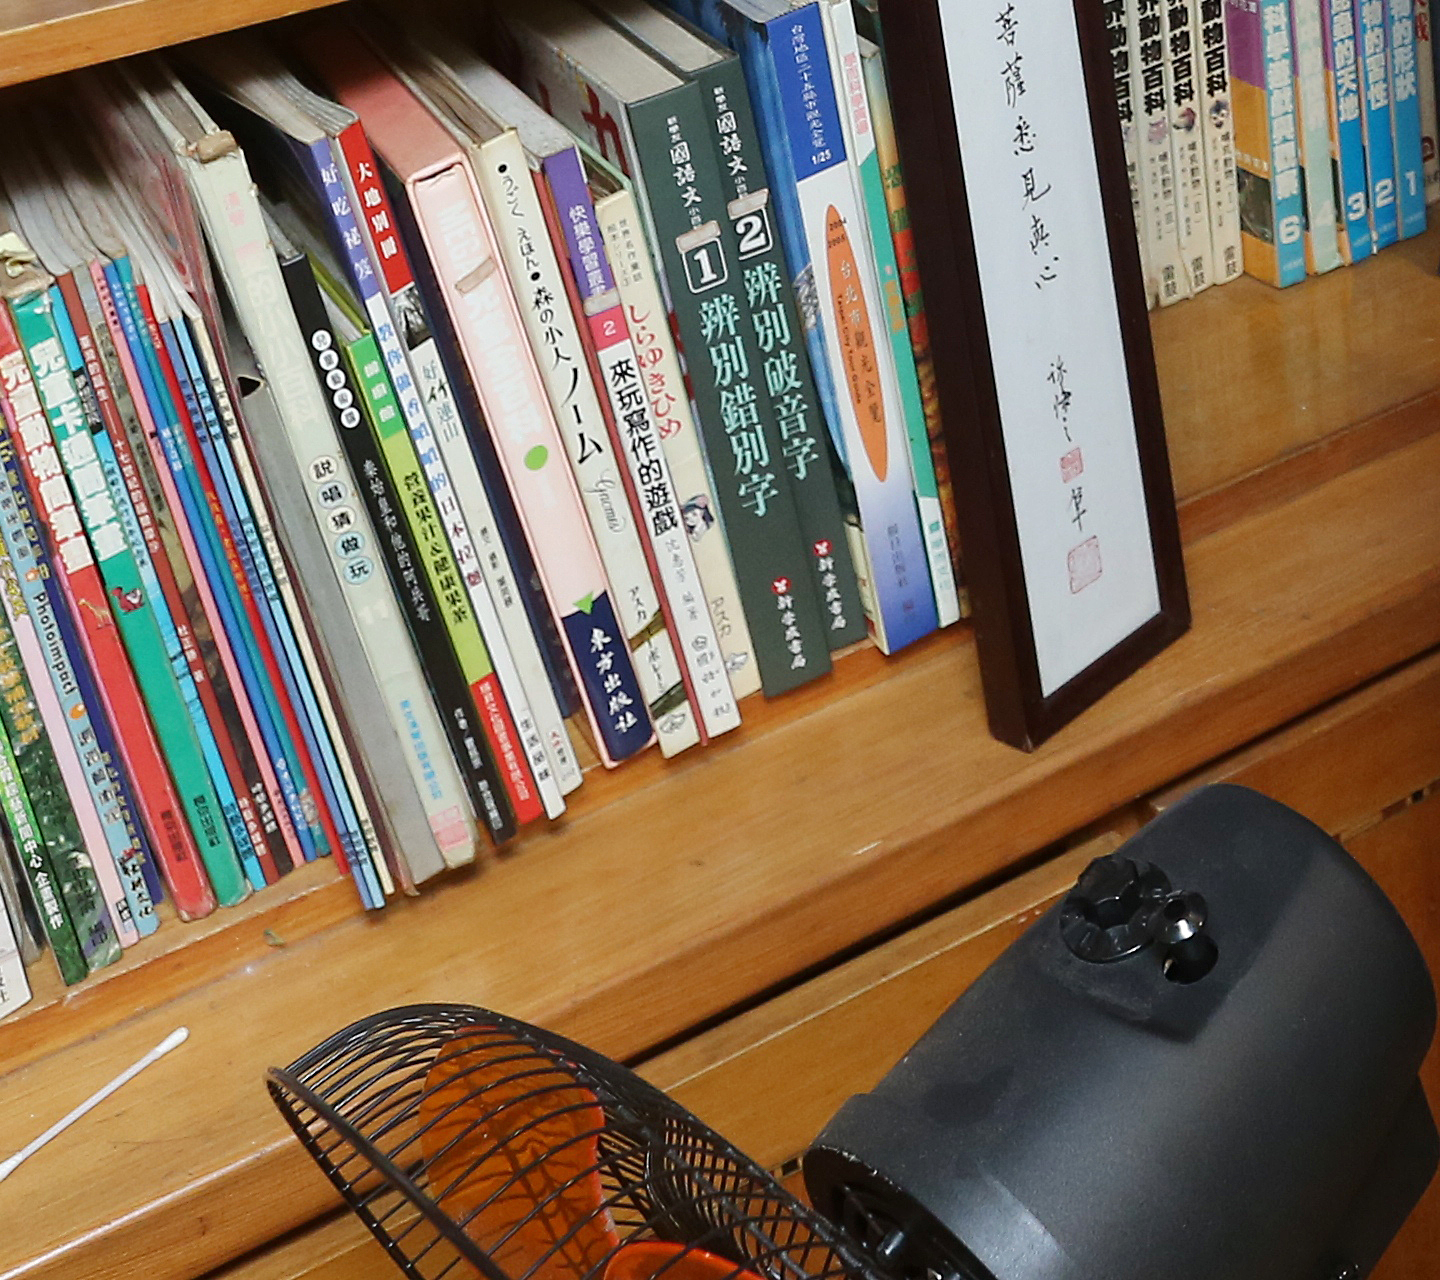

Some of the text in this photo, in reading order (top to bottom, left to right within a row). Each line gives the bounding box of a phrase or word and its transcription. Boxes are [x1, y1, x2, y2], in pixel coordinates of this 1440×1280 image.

[734, 216, 762, 253] 2
[1279, 215, 1301, 246] 6
[1346, 190, 1367, 219] 3
[1375, 178, 1395, 206] 2
[695, 249, 718, 284] 1
[516, 226, 540, 272] えほん
[530, 286, 573, 368] 森の小人
[559, 367, 603, 468] ノーム
[627, 304, 683, 440] しらゆきひめ
[741, 261, 821, 482] 辨別破音字
[609, 358, 679, 537] 來玩寫作的遊戲
[698, 293, 781, 517] 辨別錯別字
[589, 626, 639, 734] 東方出版社
